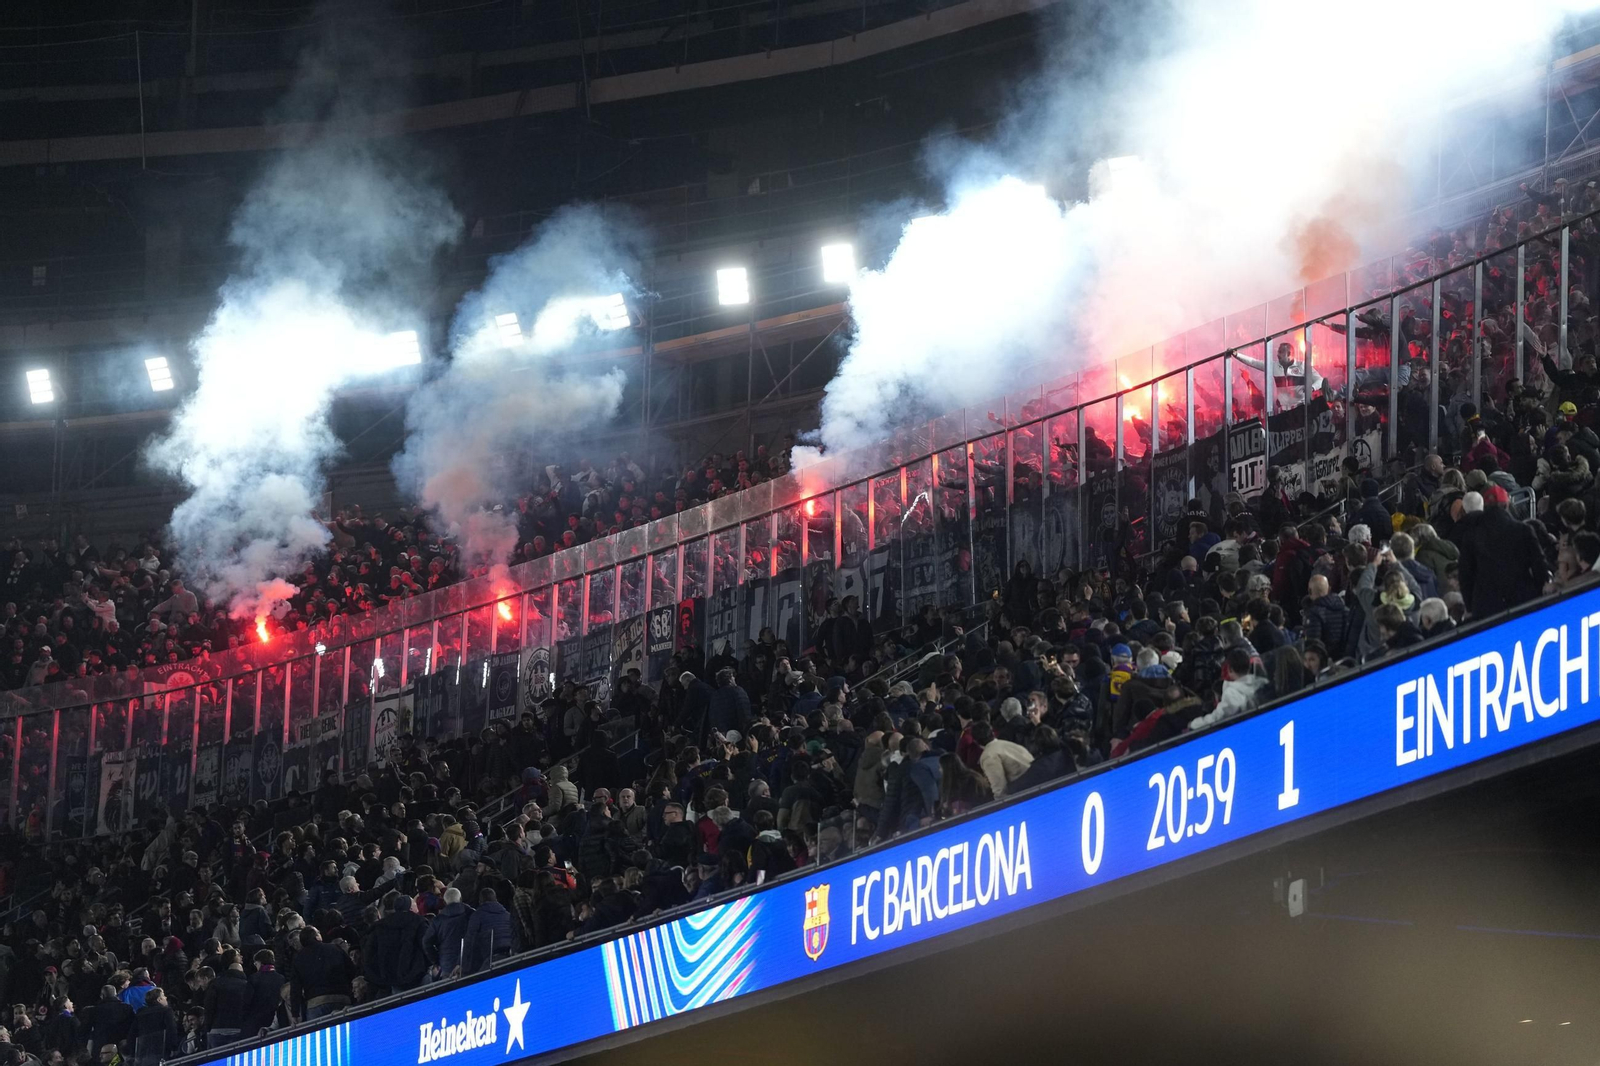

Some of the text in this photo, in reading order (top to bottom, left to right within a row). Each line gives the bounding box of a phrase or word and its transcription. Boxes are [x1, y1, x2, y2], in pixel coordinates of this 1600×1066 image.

[1231, 459, 1264, 491] ELIT
[653, 612, 668, 638] 68
[157, 662, 210, 680] EINTRACHT
[489, 705, 515, 721] RAGAZZI
[1277, 720, 1300, 810] 1
[1081, 748, 1236, 875] 0 20:59
[851, 821, 1033, 945] FC BARCELONA
[417, 998, 500, 1064] Heineken
